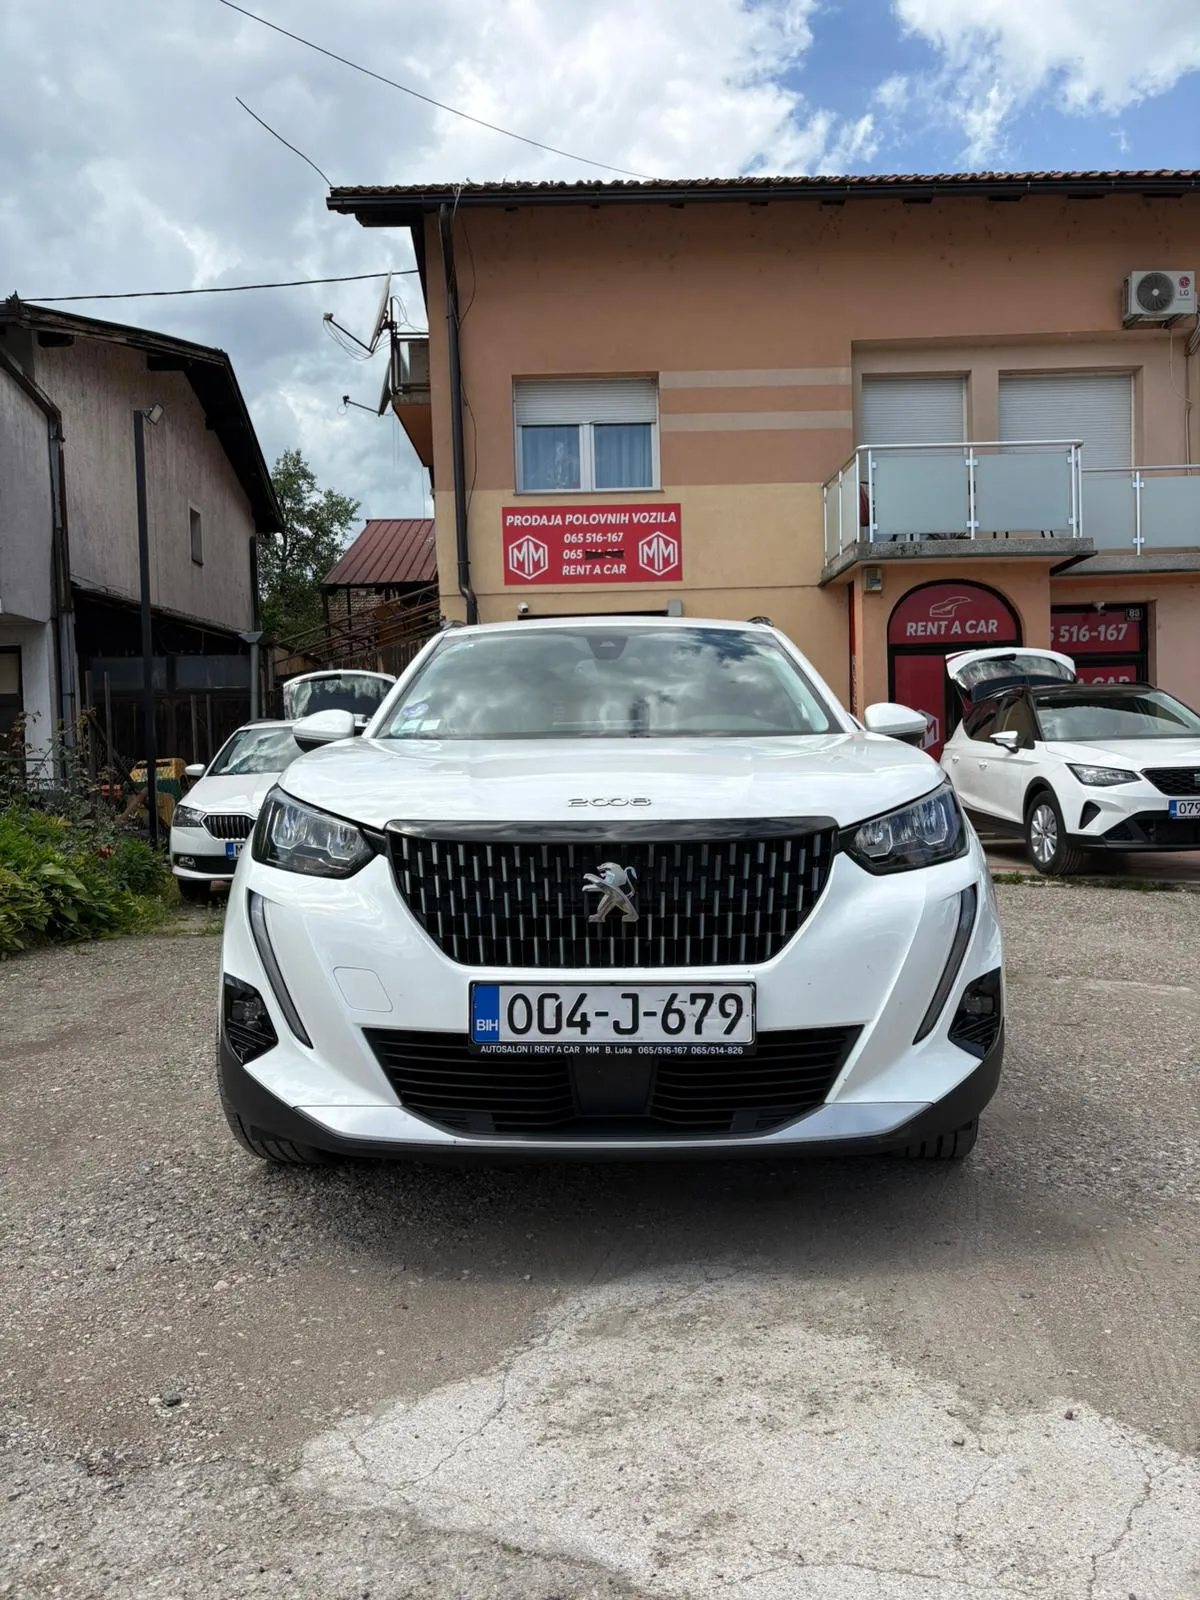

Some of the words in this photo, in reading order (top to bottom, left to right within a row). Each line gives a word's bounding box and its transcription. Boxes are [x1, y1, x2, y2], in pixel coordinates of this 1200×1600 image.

[1179, 289, 1190, 297] LG
[506, 514, 563, 526] PRODAJA
[565, 512, 629, 525] POLOVNIH
[632, 511, 677, 524] VOZILA
[563, 533, 584, 544] 065
[585, 531, 624, 543] 516-167
[562, 549, 583, 560] 065
[562, 564, 592, 576] RENT
[593, 564, 602, 575] A
[603, 563, 627, 575] CAR
[906, 621, 949, 637] RENT
[951, 620, 962, 634] A
[965, 619, 998, 634] CAR
[1058, 623, 1128, 642] 516-167
[567, 798, 652, 808] 2008
[476, 1019, 498, 1031] BIH
[507, 992, 744, 1036] 004-J-679
[480, 1045, 528, 1054] AUTOSALON
[534, 1045, 555, 1054] RENT
[556, 1045, 562, 1054] A
[563, 1045, 581, 1054] CAR
[585, 1046, 600, 1054] MM
[605, 1046, 613, 1054] B.
[614, 1046, 633, 1055] Luka
[637, 1046, 688, 1055] 065/516-167
[691, 1046, 744, 1055] 065/514-826
